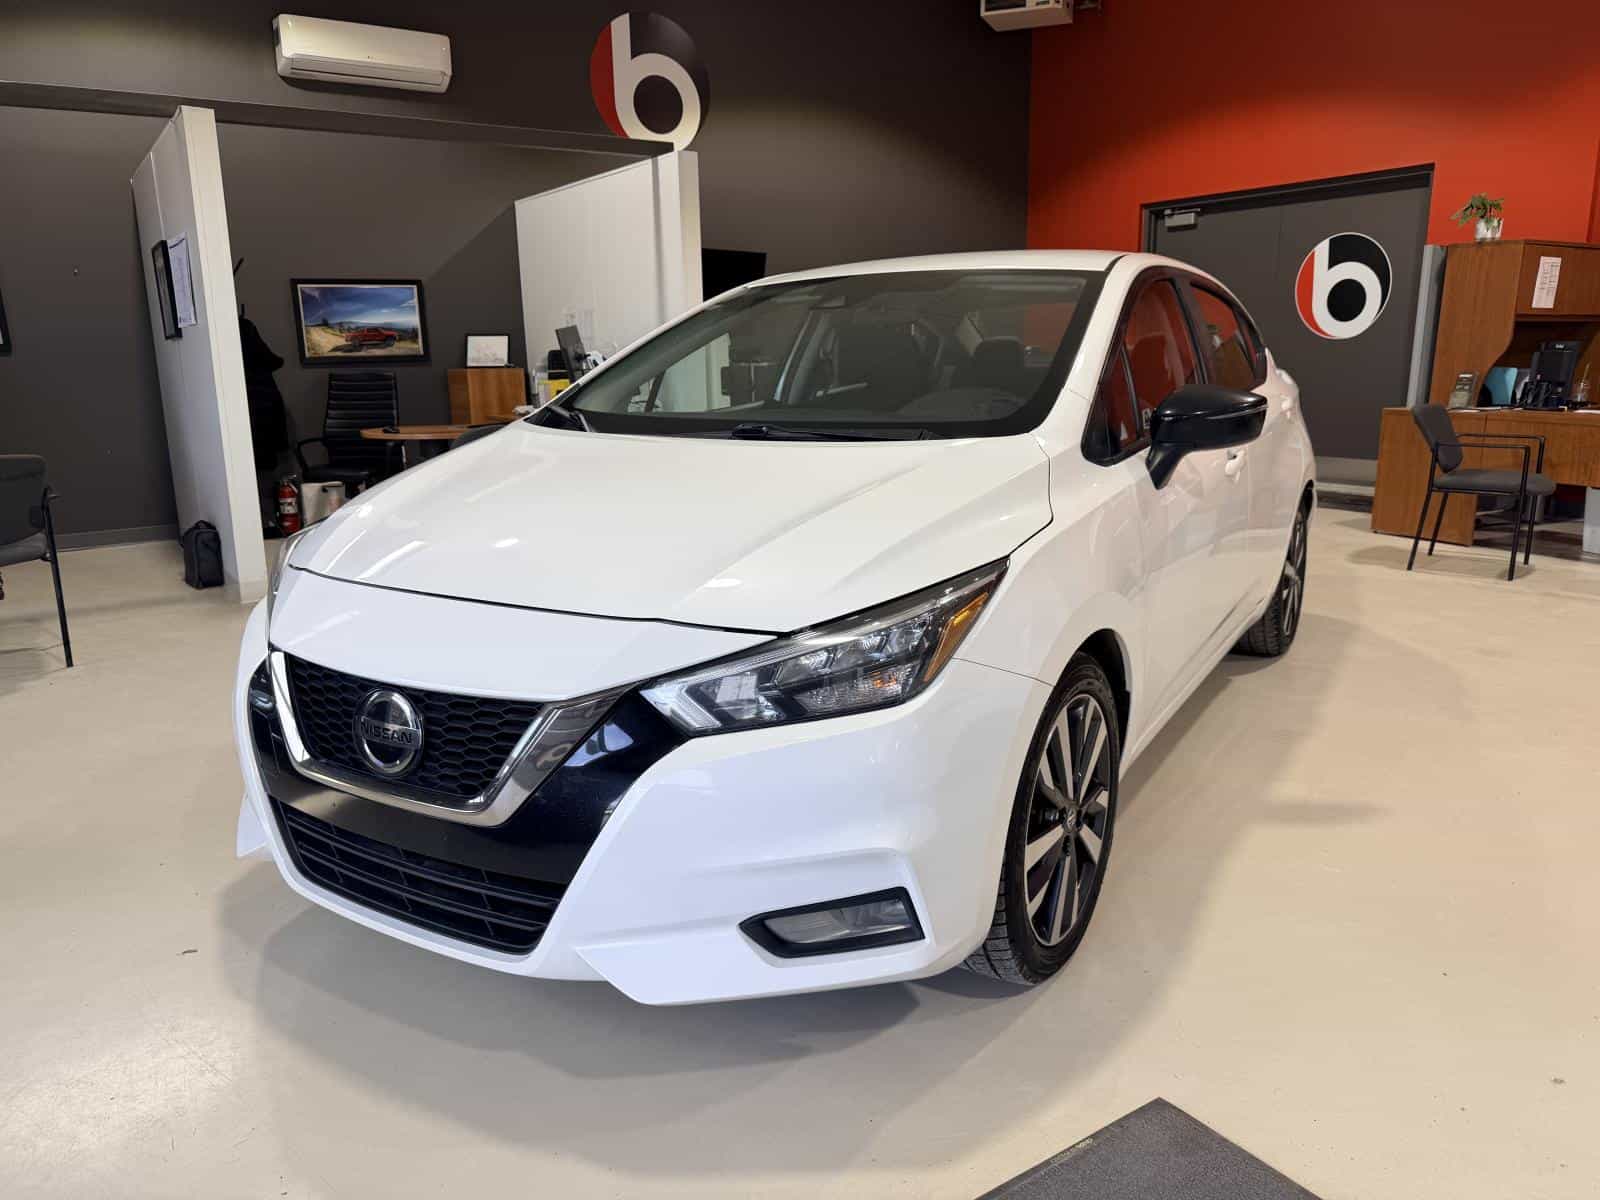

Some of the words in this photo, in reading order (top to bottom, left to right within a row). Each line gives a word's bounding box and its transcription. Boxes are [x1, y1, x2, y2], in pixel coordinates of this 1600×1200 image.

[610, 12, 701, 152] b
[1312, 238, 1382, 339] b
[360, 720, 412, 743] NISSAN
